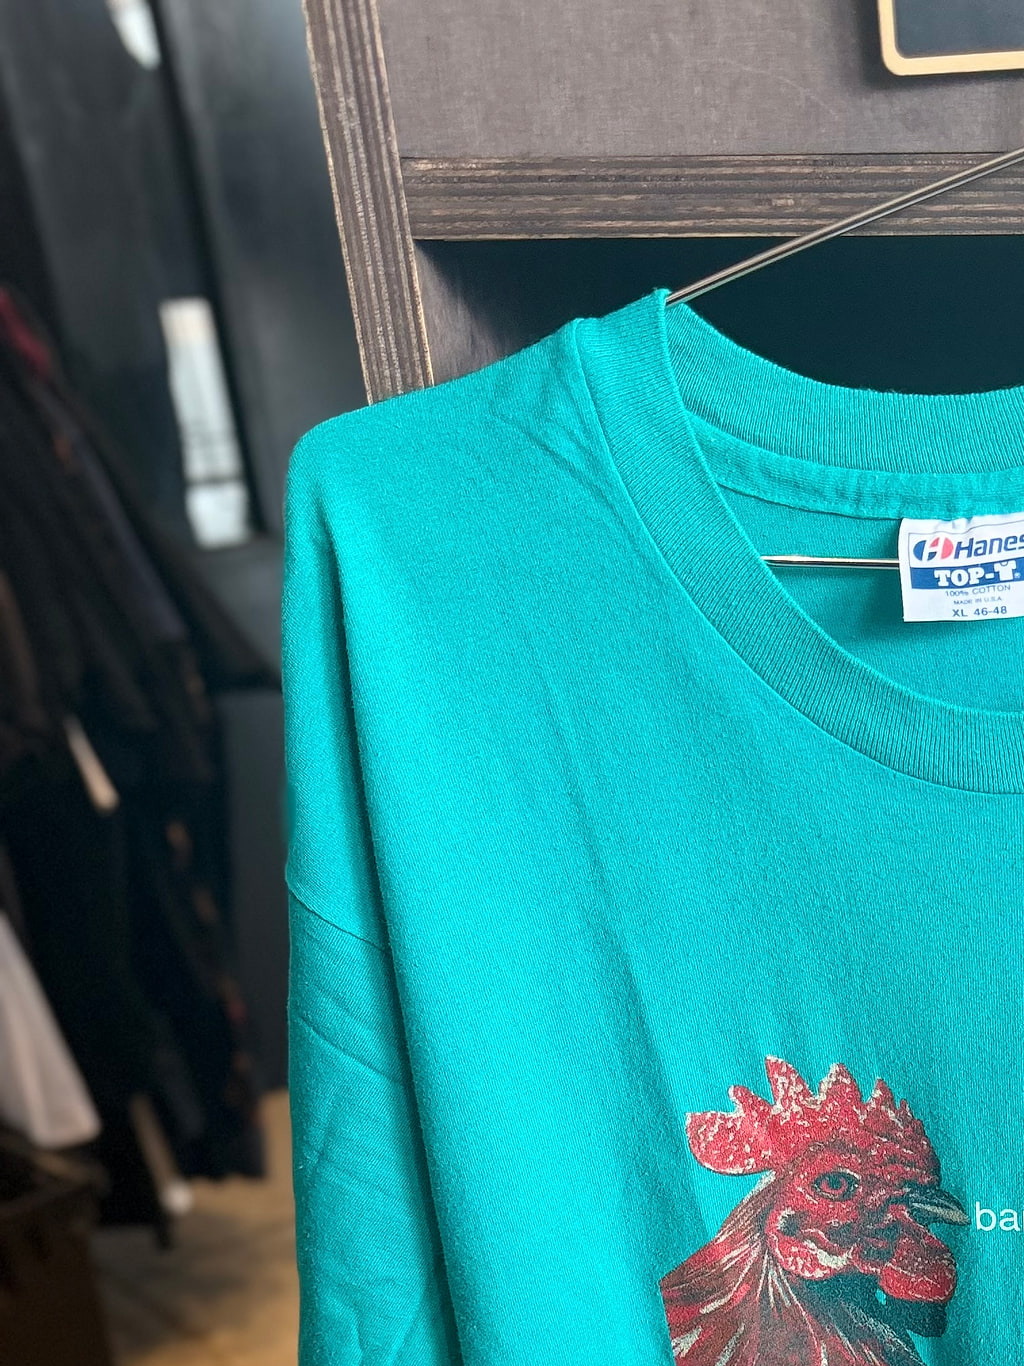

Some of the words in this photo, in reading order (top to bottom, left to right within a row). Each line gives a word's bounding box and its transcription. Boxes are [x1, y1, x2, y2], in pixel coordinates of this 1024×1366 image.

[972, 584, 1011, 595] COTTON
[952, 608, 968, 618] XL
[973, 605, 1008, 616] 46-48
